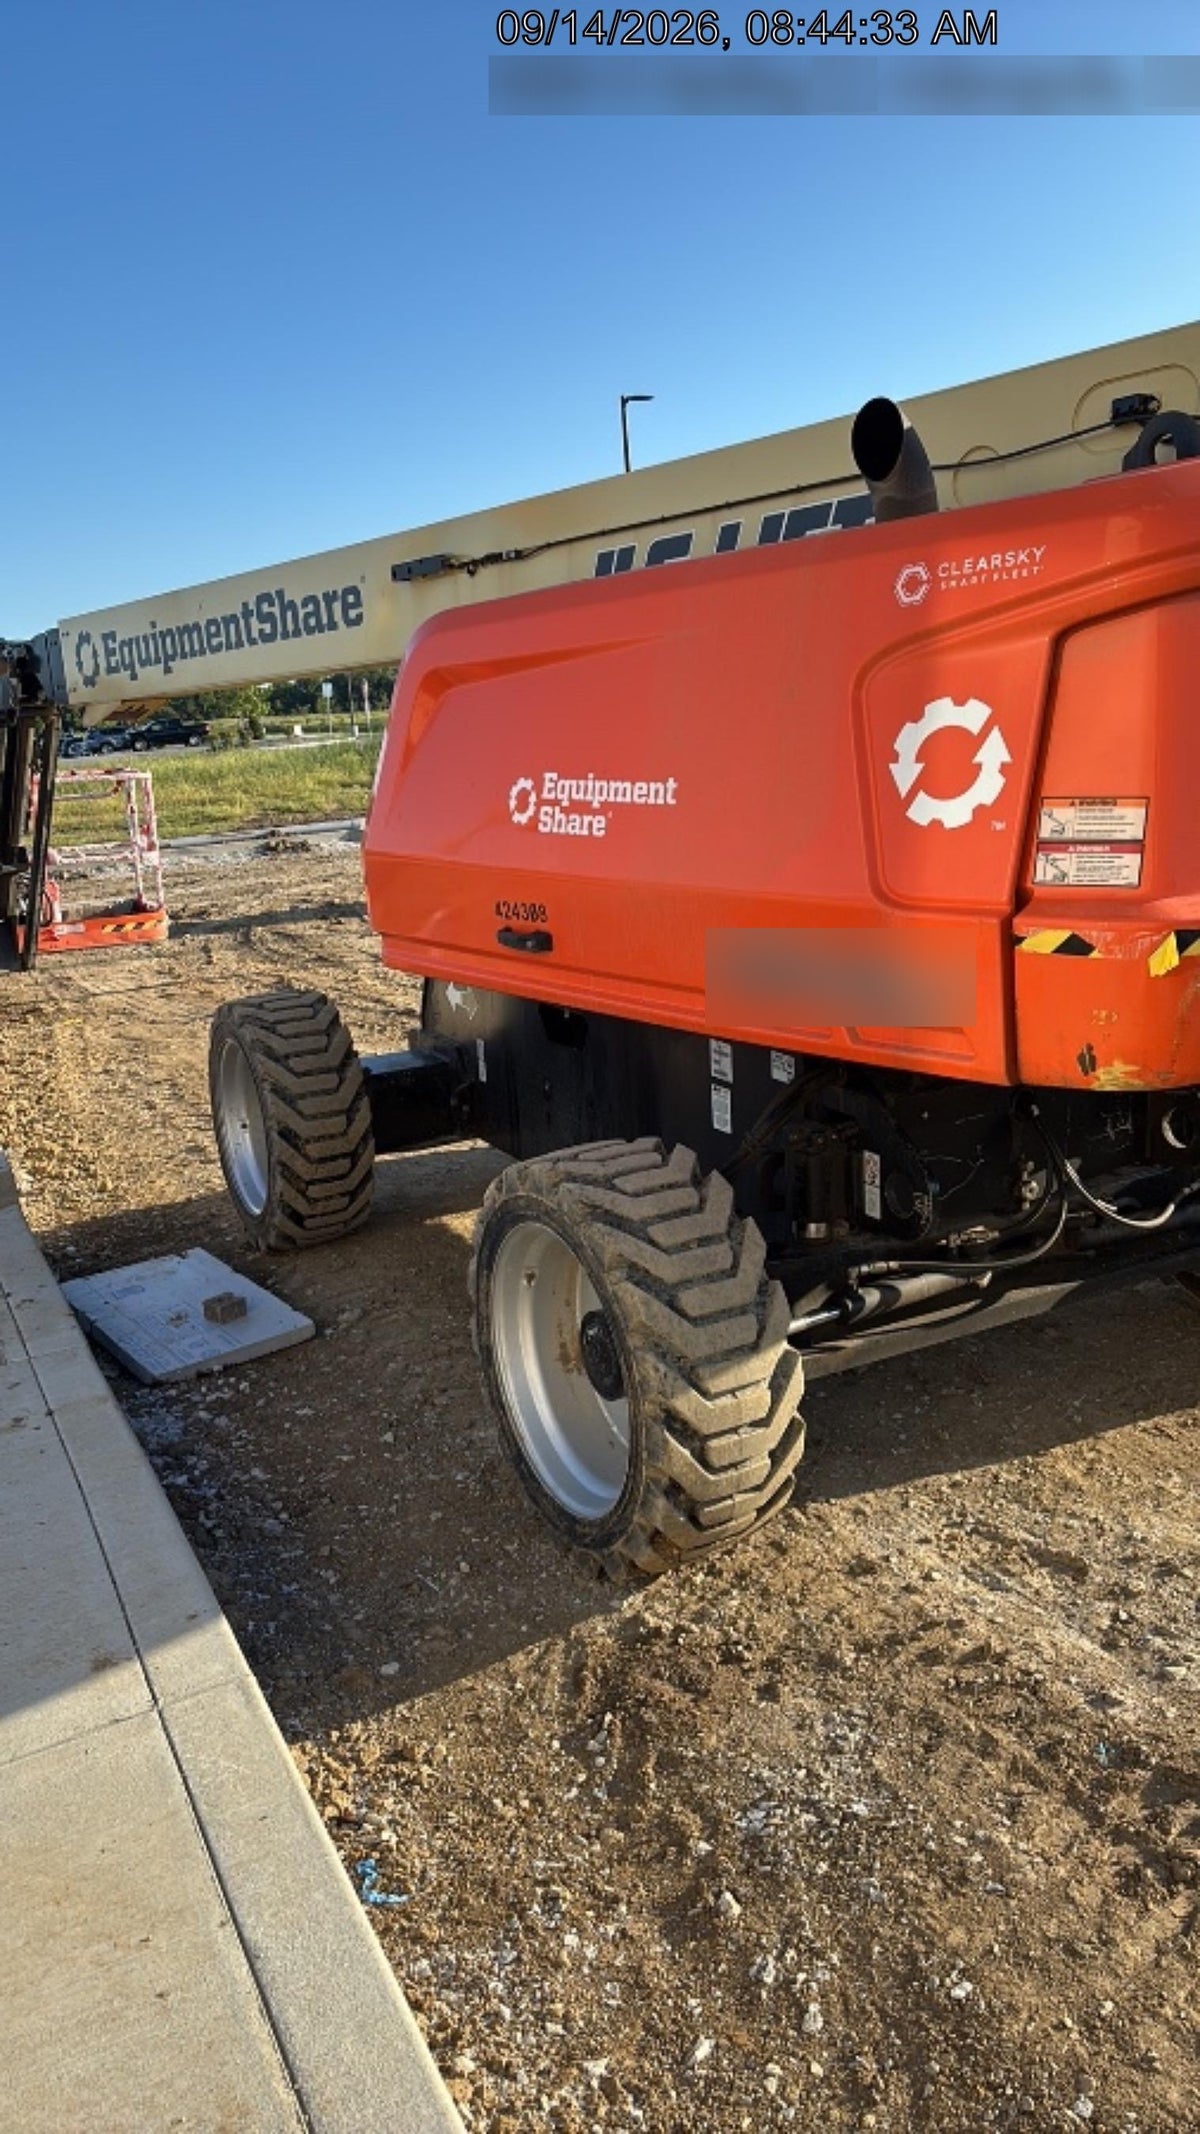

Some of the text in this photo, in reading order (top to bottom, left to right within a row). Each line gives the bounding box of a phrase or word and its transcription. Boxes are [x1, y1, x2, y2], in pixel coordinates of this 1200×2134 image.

[938, 545, 1046, 577] CLEARSKY
[993, 566, 1040, 582] FLEET
[102, 586, 363, 680] EquipmentShare
[542, 772, 677, 808] Equipment
[537, 805, 606, 838] Share
